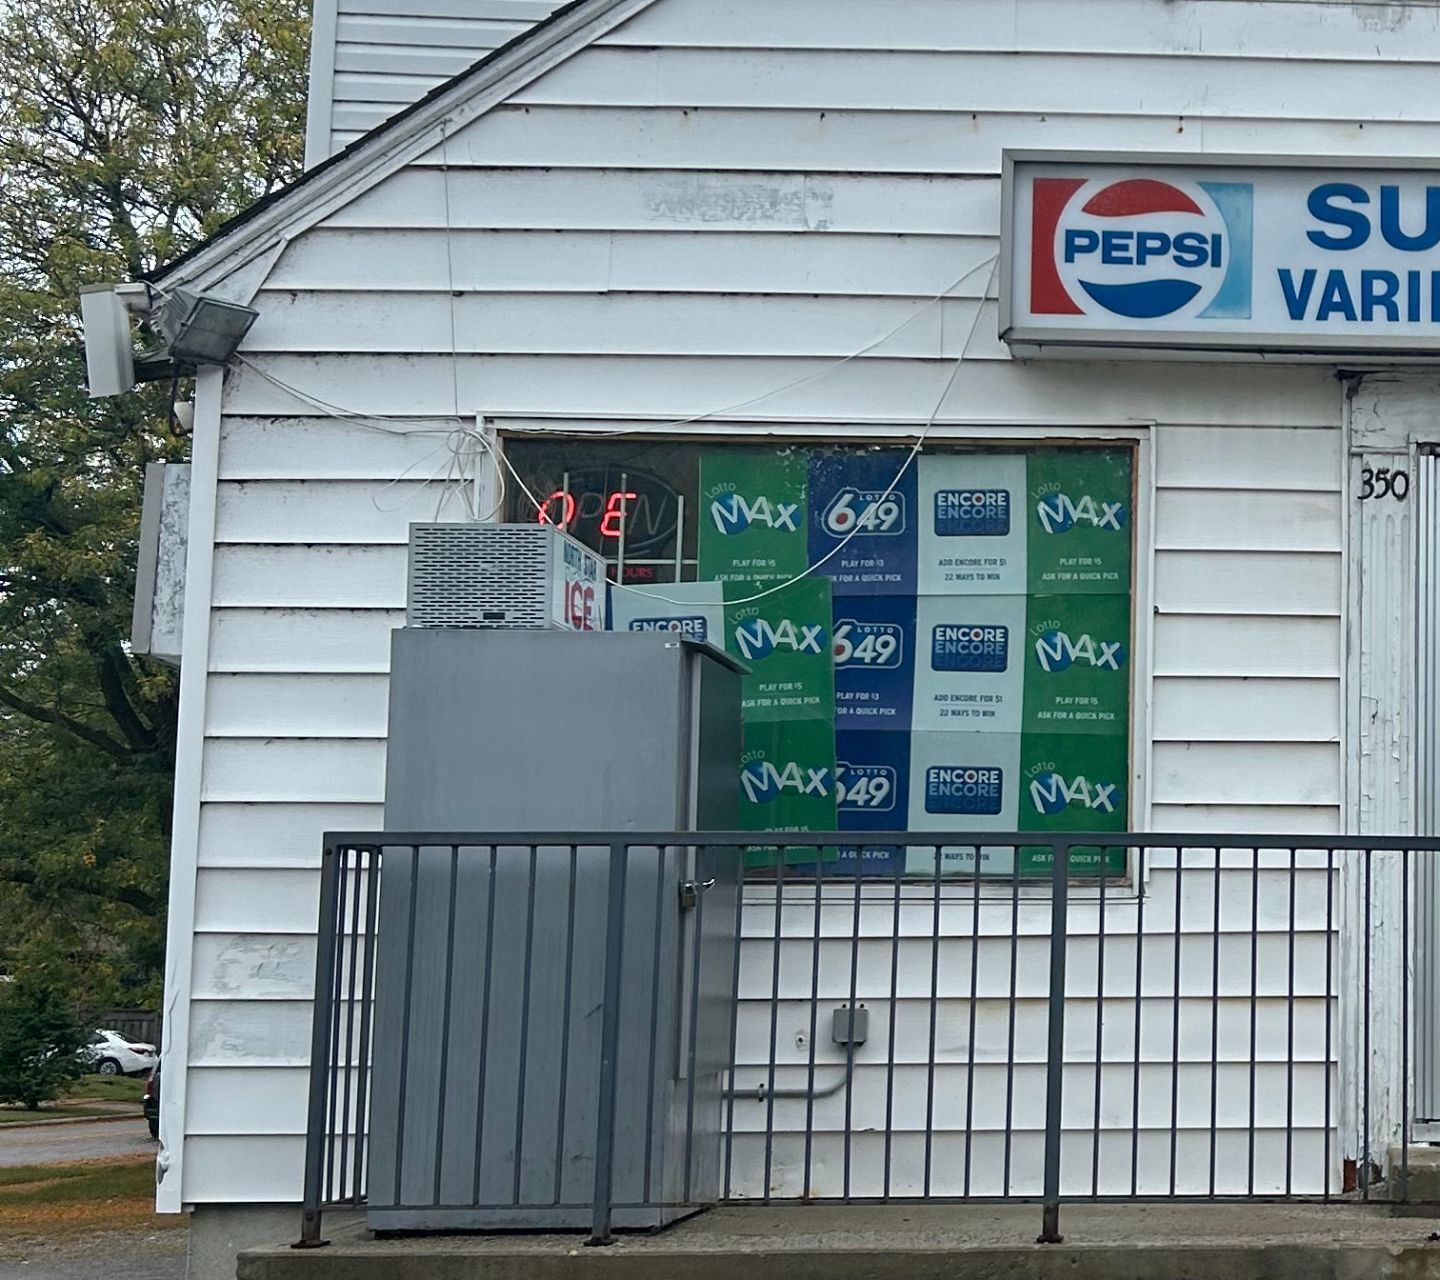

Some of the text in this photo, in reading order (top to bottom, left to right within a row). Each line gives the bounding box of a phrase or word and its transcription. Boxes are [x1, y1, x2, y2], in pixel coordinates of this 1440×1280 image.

[1064, 229, 1222, 270] PEPSI
[1360, 467, 1410, 501] 350
[937, 492, 1007, 506] ENCORE
[828, 493, 899, 532] 649
[937, 506, 1007, 519] ENCORE
[733, 559, 750, 568] PLAY
[752, 559, 766, 567] FOR
[841, 559, 859, 568] PLAY
[861, 559, 874, 568] FOR
[938, 558, 953, 567] ADD
[955, 558, 982, 567] ENCORE
[984, 558, 998, 567] FOR
[1060, 557, 1077, 566] PLAY
[1079, 557, 1092, 566] FOR
[839, 574, 853, 582] FOR
[854, 574, 860, 582] A
[861, 573, 883, 582] QUICK
[885, 573, 902, 582] PICK
[944, 573, 1001, 581] 22 WAYS TO WIN
[564, 579, 595, 631] ICE
[632, 619, 704, 633] ENCORE
[935, 627, 1006, 642] ENCORE
[833, 625, 897, 665] 649
[935, 641, 1005, 655] ENCORE
[759, 682, 777, 691] PLAY
[779, 682, 793, 691] FOR
[836, 692, 854, 700] PLAY
[856, 692, 869, 700] FOR
[933, 694, 949, 702] ADD
[951, 694, 978, 703] ENCORE
[980, 694, 994, 703] FOR
[1056, 696, 1073, 705] PLAY
[1075, 697, 1089, 705] FOR
[742, 697, 820, 708] ASK FOR A QUICK PICK
[856, 707, 877, 715] QUICK
[879, 707, 896, 715] PICK
[939, 709, 996, 717] 22 WAYS TO WIN
[1037, 711, 1115, 721] ASK FOR A QUICK PICK
[740, 749, 765, 766] otto
[851, 768, 888, 776] LOTTO
[929, 769, 1000, 783] ENCORE
[928, 783, 999, 797] ENCORE
[872, 851, 890, 859] PICK
[1032, 854, 1046, 862] ASK
